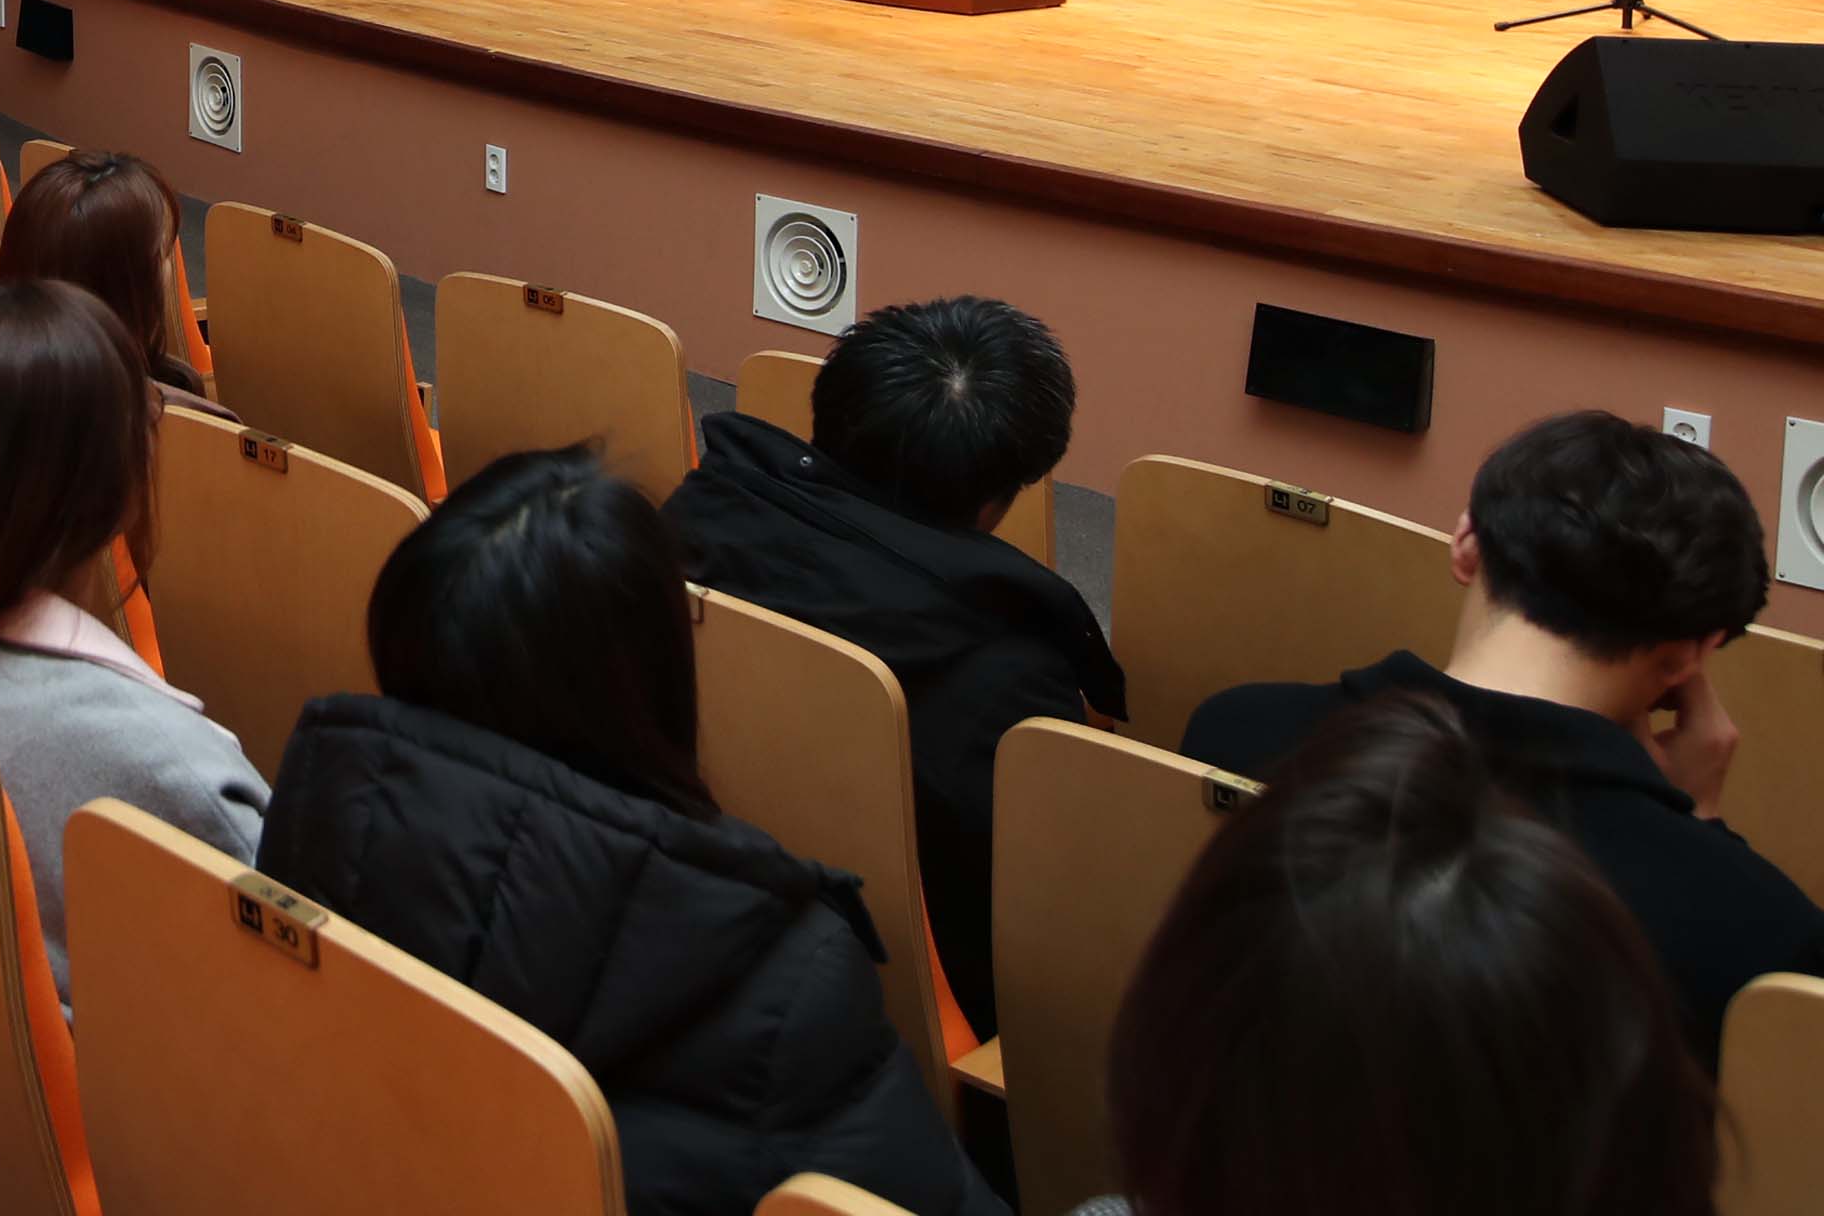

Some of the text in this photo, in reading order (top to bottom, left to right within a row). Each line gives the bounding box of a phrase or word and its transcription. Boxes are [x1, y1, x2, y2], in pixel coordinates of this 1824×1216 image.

[264, 448, 277, 463] 17
[1296, 500, 1316, 515] 07
[274, 917, 298, 949] 30
